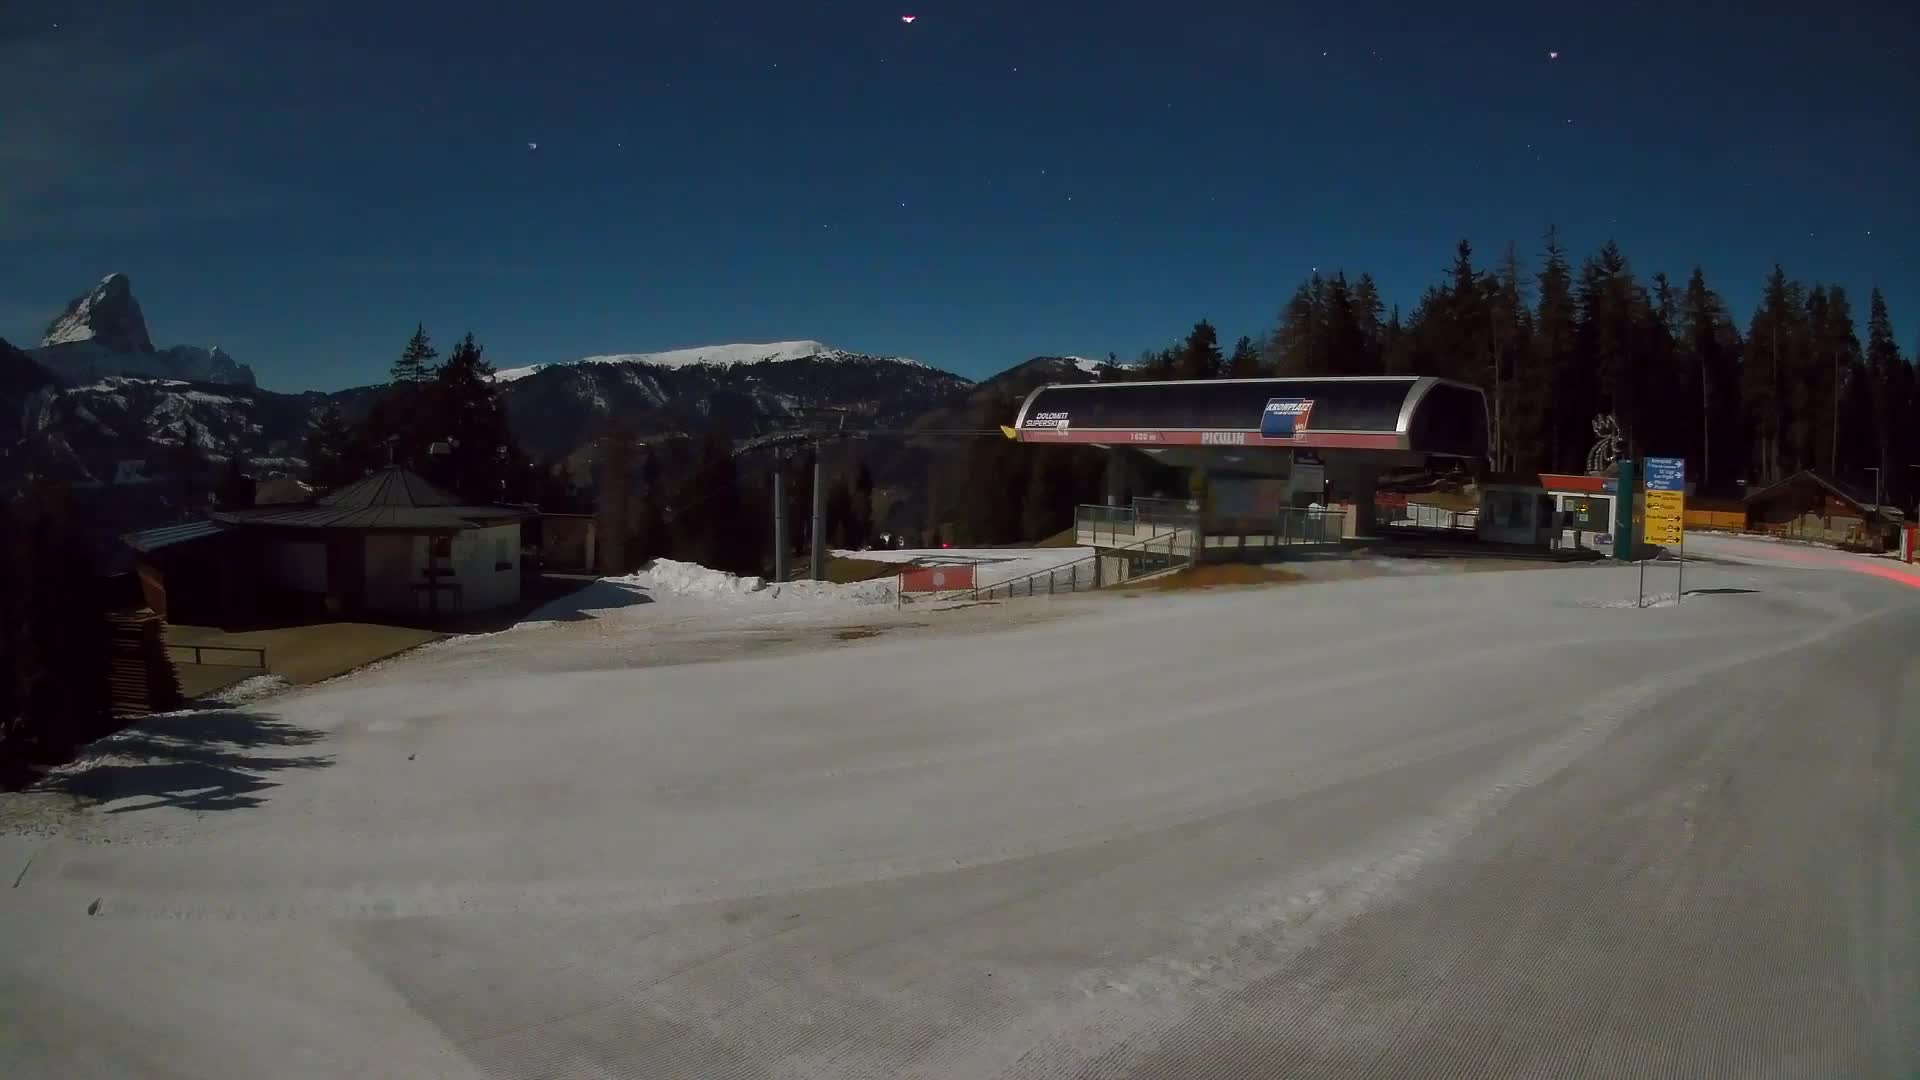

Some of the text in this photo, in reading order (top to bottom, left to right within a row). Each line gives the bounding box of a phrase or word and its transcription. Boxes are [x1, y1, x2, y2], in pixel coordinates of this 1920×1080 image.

[1036, 412, 1069, 420] DOLOMITI
[1025, 419, 1058, 427] SUPERSKI
[1201, 432, 1245, 445] PICULIN
